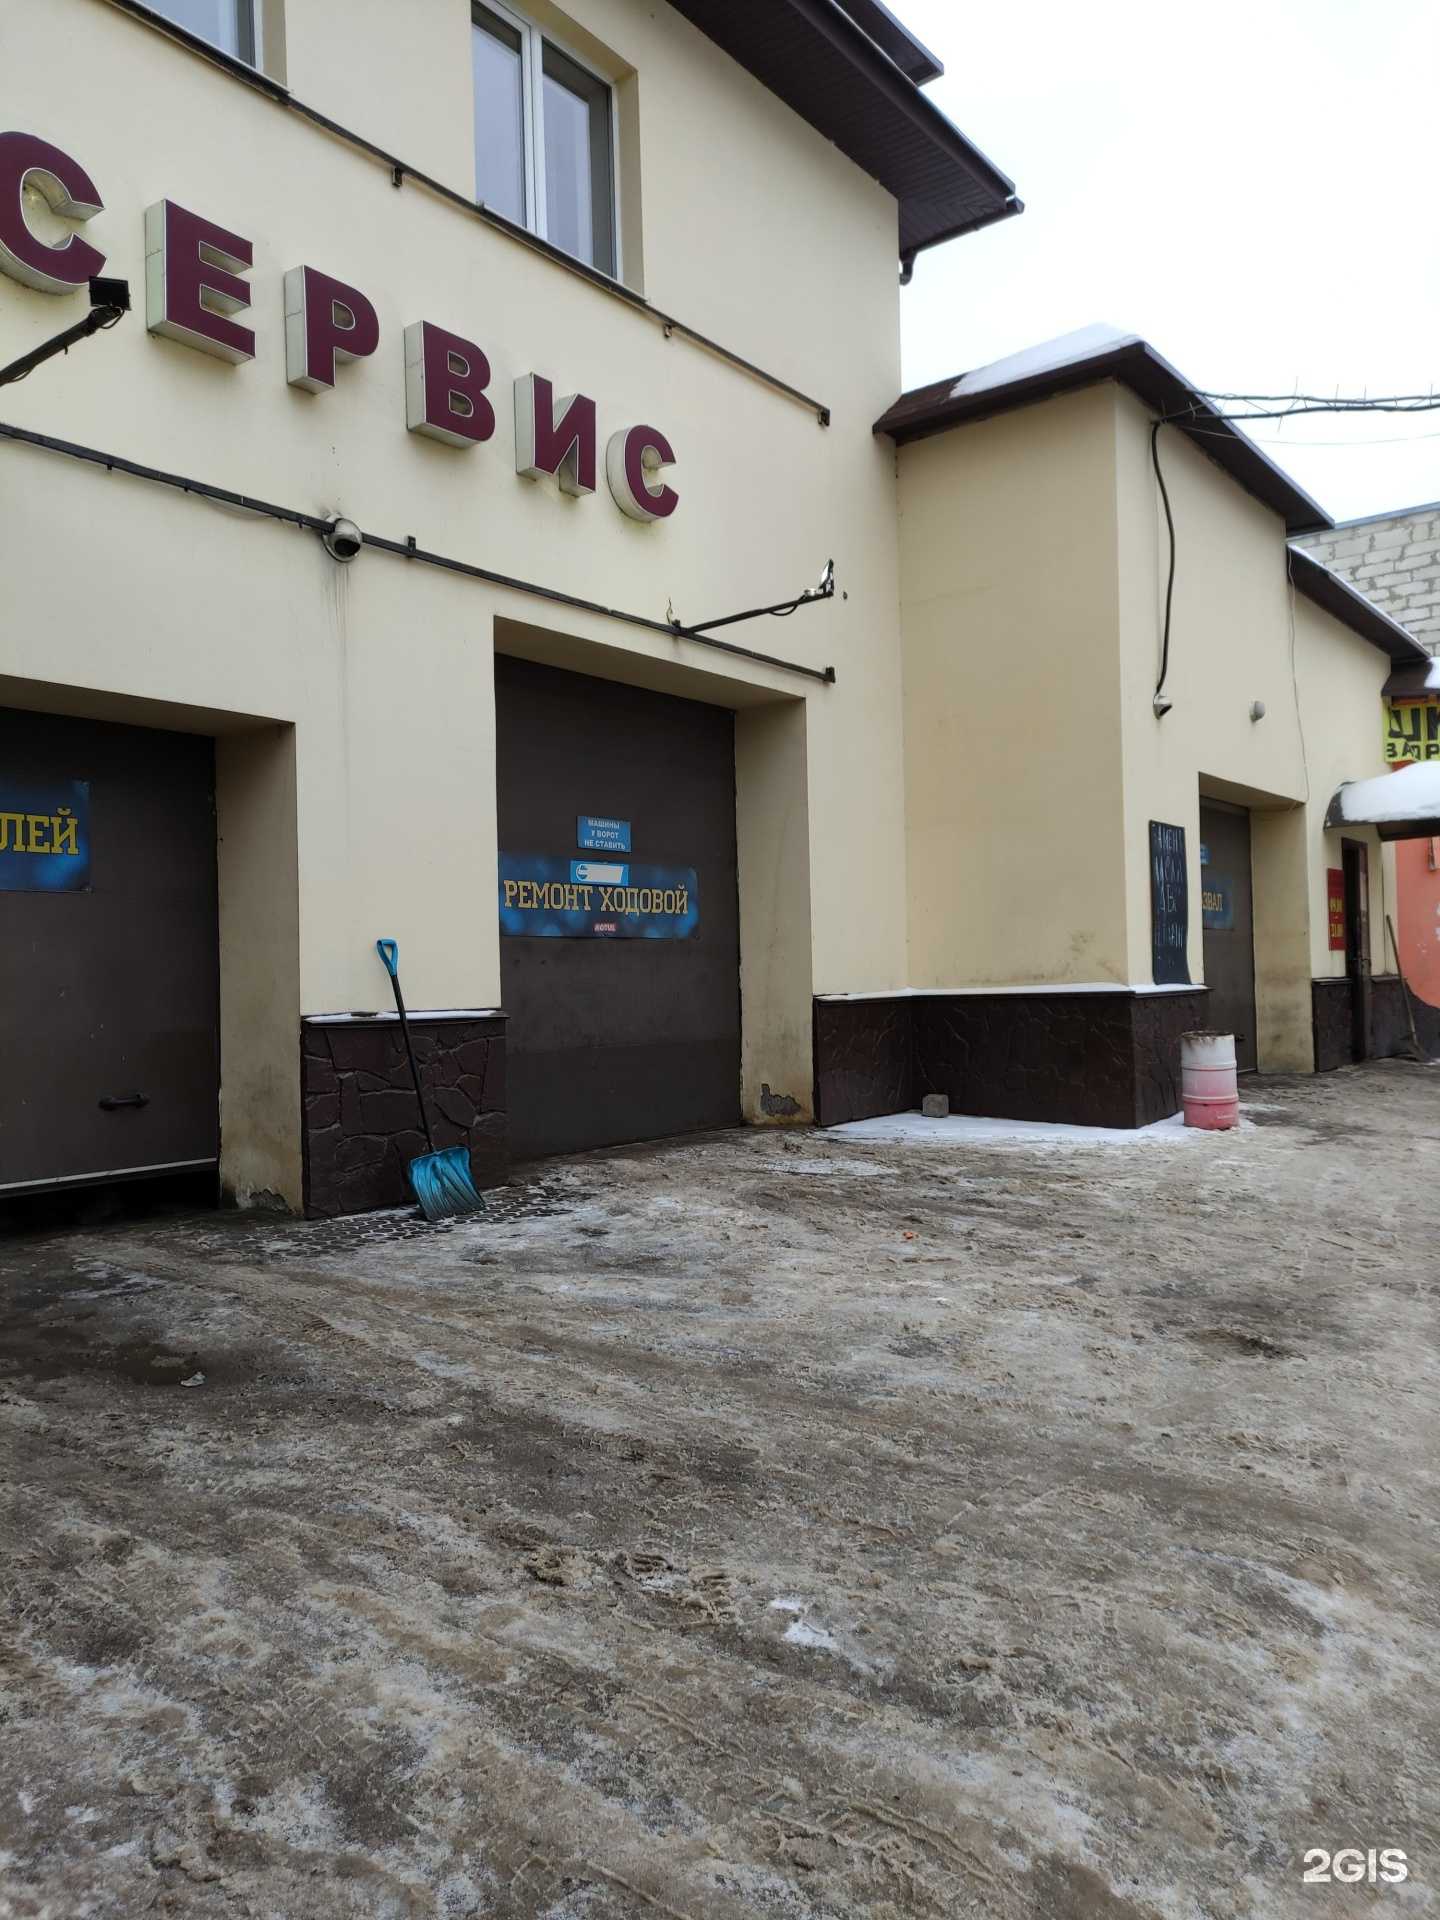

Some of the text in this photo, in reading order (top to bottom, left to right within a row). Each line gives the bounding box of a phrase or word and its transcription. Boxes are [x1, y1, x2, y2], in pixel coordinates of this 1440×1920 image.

[0, 131, 679, 522] СЕРВИС
[0, 806, 79, 855] ЛЕЙ
[587, 819, 620, 829] МАШИНЫ
[596, 830, 619, 838] ВОРОТ
[584, 839, 625, 850] НЕ СТАВИТЬ
[503, 880, 688, 917] РЕМОНТ ХОДОВОЙ
[1201, 891, 1223, 912] ЗВАЛ
